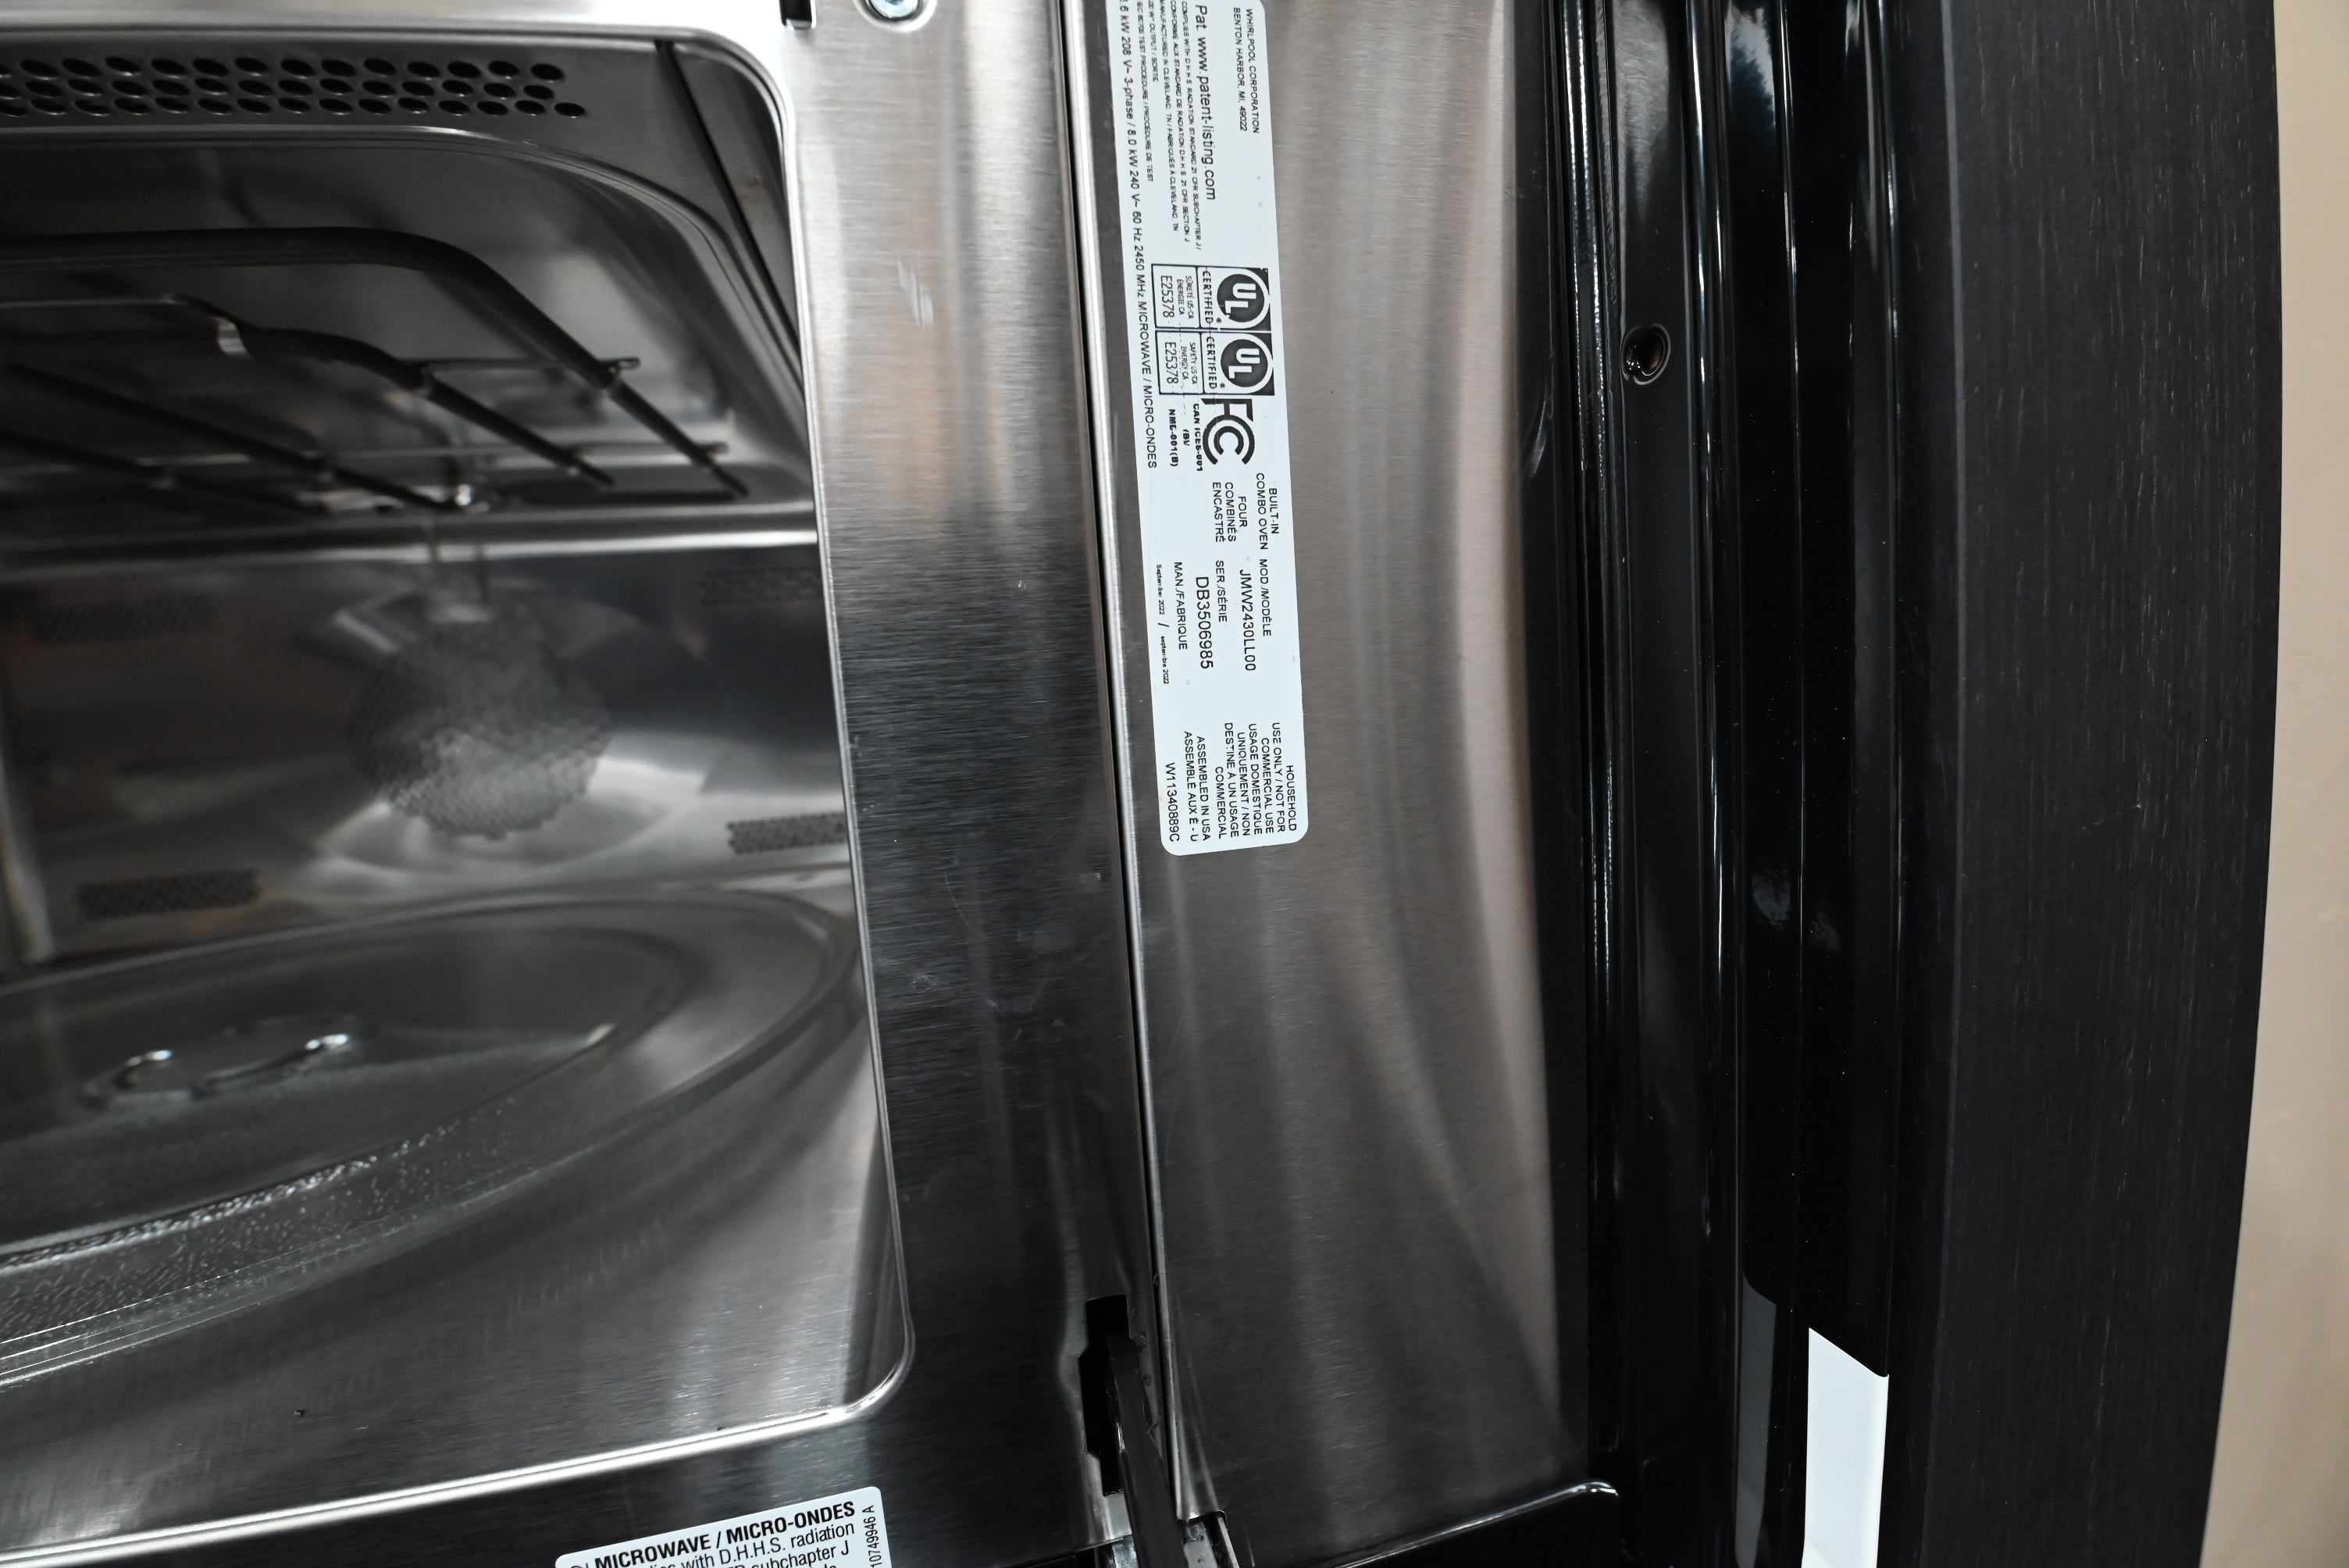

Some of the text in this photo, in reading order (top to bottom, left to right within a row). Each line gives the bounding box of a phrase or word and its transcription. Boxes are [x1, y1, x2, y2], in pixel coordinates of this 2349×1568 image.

[1121, 16, 1129, 33] kW
[1121, 37, 1131, 55] 208
[1236, 48, 1245, 87] HARBOR,
[1246, 9, 1259, 133] WHIRLPOOL CORPORATION
[1128, 130, 1136, 145] 8.0
[1196, 37, 1215, 200] www.patent-listing.com
[1129, 150, 1138, 167] kW
[1130, 170, 1139, 189] 240
[1132, 212, 1141, 223] 60
[1134, 228, 1142, 241] Hz
[1135, 245, 1144, 270] 2450
[1137, 275, 1146, 298] MHz
[1160, 276, 1174, 318] E25378
[1203, 270, 1213, 323] CERTIFIED
[1139, 301, 1151, 374] MICROWAVE
[1164, 342, 1178, 384] E25378
[1206, 337, 1217, 389] CERTIFIED
[1143, 386, 1157, 468] MICRO-ONDES
[1213, 483, 1226, 542] ENCASTRÉ
[1225, 483, 1238, 541] COMBINÉS
[1238, 497, 1247, 527] FOUR
[1256, 473, 1268, 549] COMBO OVEN
[1269, 488, 1279, 533] BUILT-IN
[1196, 577, 1214, 668] DB3506985
[1240, 569, 1256, 671] JMW2430LL00
[1272, 722, 1281, 744] USE
[1185, 732, 1196, 789] ASSEMBLÉ
[1238, 732, 1249, 804] UNIQUEMENT
[1249, 724, 1262, 835] USAGE DOMESTIQUE
[1274, 747, 1282, 775] ONLY
[1166, 762, 1179, 842] W11340889C
[1188, 793, 1197, 814] AUX
[1196, 736, 1210, 840] ASSEMBLED IN USA
[1215, 767, 1227, 839] COMMERCIAL
[1228, 782, 1236, 797] UN
[1261, 738, 1274, 833] COMMERCIAL USE
[1275, 786, 1284, 807] NOT
[1286, 765, 1296, 831] HOUSEHOLD
[1229, 801, 1239, 838] USAGE
[1242, 813, 1250, 836] NON
[1277, 811, 1285, 832] FOR
[595, 1534, 711, 1568] MICROWAVE
[726, 1501, 855, 1544] MICRO-ONDES
[790, 1523, 855, 1548] radiation
[841, 1540, 850, 1556] J
